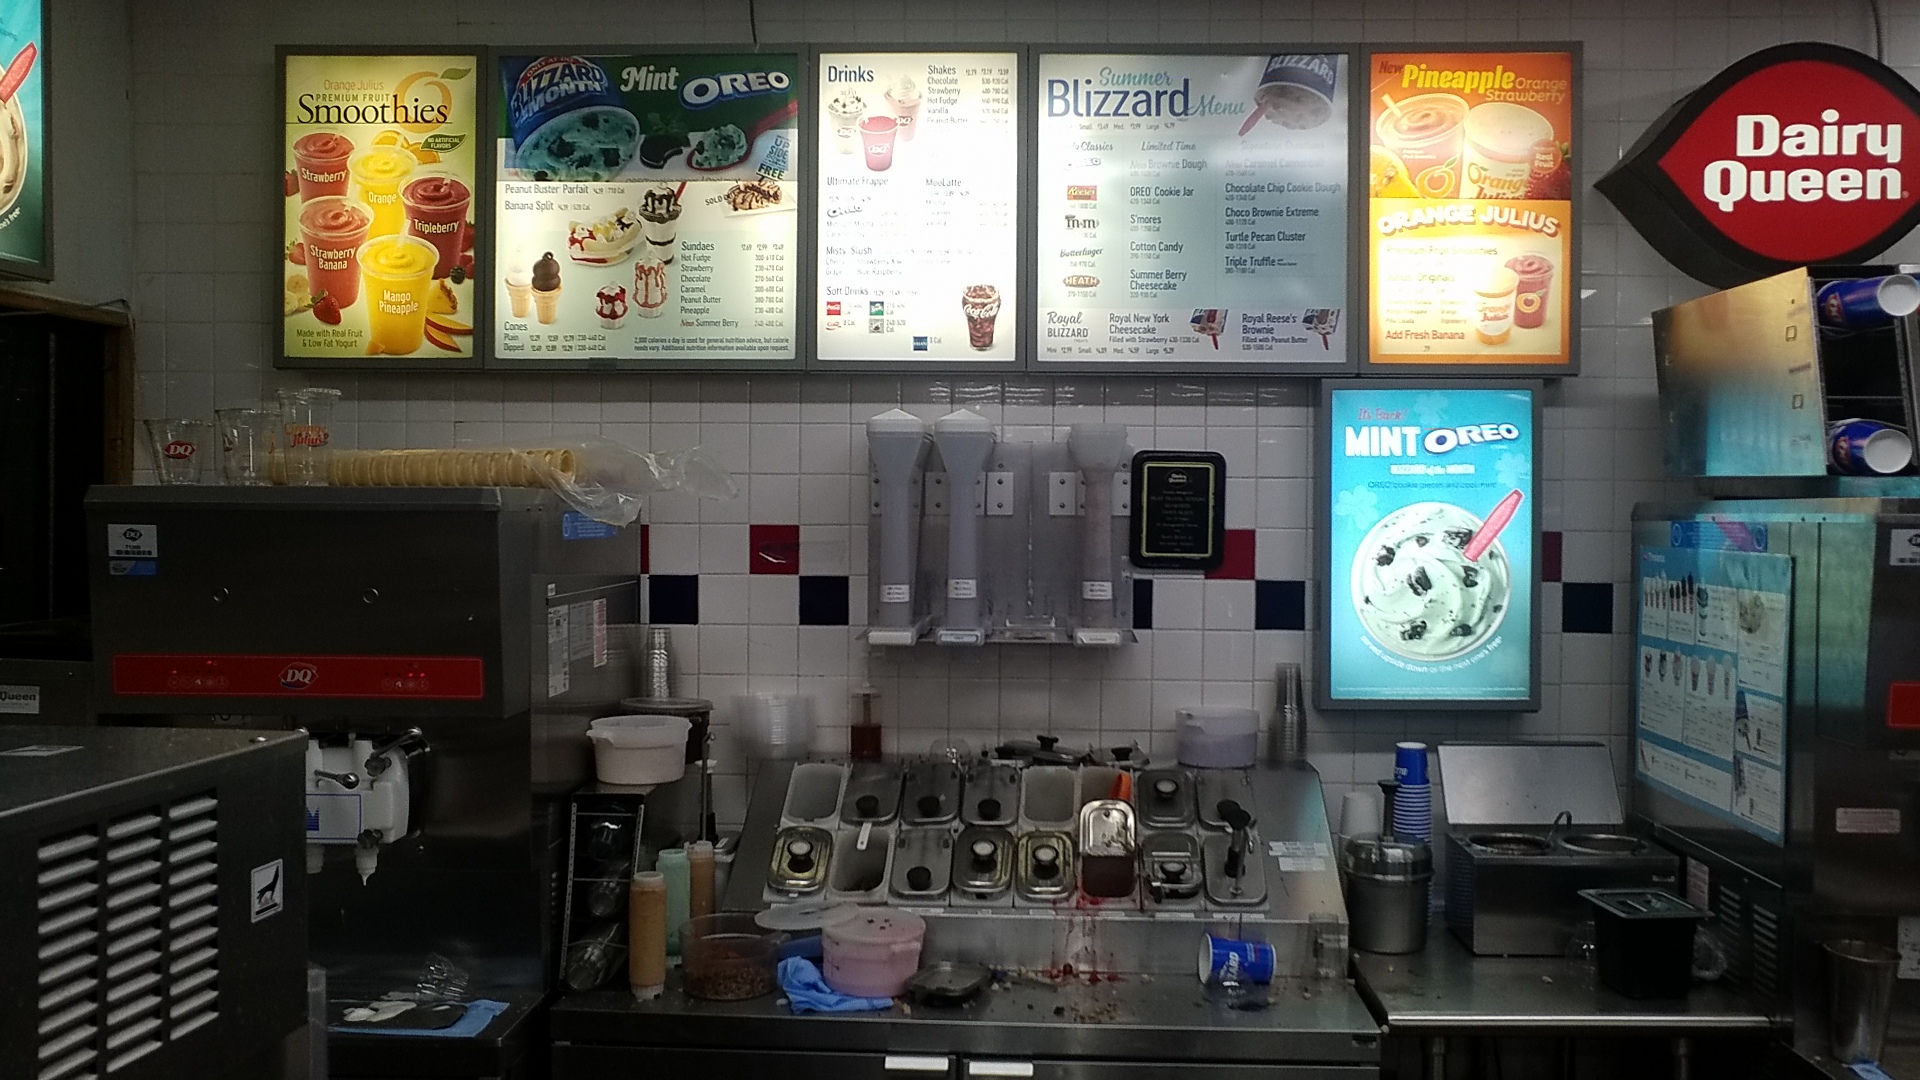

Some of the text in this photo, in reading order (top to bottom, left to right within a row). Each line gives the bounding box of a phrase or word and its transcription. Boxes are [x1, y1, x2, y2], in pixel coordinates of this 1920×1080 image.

[526, 61, 546, 76] ONLY
[828, 64, 874, 82] Drinks
[927, 64, 957, 75] Shakes
[1267, 54, 1335, 86] BLIZZARD
[927, 76, 958, 85] Chocolate
[1099, 66, 1173, 87] Summer
[1379, 61, 1567, 94] New Pineapple Orange
[324, 79, 384, 92] Orange Julius
[620, 65, 790, 105] Mint OREO
[927, 86, 961, 96] Strawberry
[1485, 88, 1566, 104] Strawberry
[315, 93, 391, 102] PREMIUM FRUIT
[939, 97, 958, 106] Fudge
[1047, 77, 1245, 118] Blizzard Menu
[297, 93, 449, 124] Smoothies
[1736, 109, 1903, 163] Dairy
[1080, 141, 1113, 151] Classics
[1141, 141, 1196, 151] Limited Time
[1148, 159, 1207, 171] Brownie Dough
[301, 167, 347, 183] Strawberry
[758, 163, 784, 180] FREE
[827, 176, 889, 187] Ultimate Frappe
[1703, 160, 1902, 212] Queen
[504, 183, 589, 194] Peanut Buster Parfait
[1130, 186, 1194, 197] OREO Cookie Jar
[1225, 182, 1341, 194] Chocolate Chip Cookie Dough
[368, 191, 397, 206] Orange
[705, 195, 722, 206] SOLD
[504, 200, 554, 212] Banana Split
[1225, 206, 1319, 217] Choco Brownie Extreme
[1130, 214, 1162, 224] S'mores
[1378, 203, 1560, 236] ORANGE JULIUS
[413, 219, 459, 235] Tripleberry
[1225, 231, 1306, 241] Turtle Pecan Cluster
[681, 240, 715, 251] Sundaes
[850, 245, 873, 255] Slush
[1130, 241, 1184, 254] Cotton Candy
[310, 244, 356, 260] Strawberry
[1059, 247, 1104, 258] Butterfinger
[680, 253, 711, 263] Hot Fudge
[1225, 256, 1248, 269] Triple
[1249, 256, 1275, 267] Truffle
[318, 259, 348, 270] Banana
[680, 263, 714, 273] Strawberry
[680, 274, 711, 283] Chocolate
[1065, 276, 1097, 285] HEATH
[1130, 269, 1187, 281] Summer Berry
[680, 285, 706, 293] Caramel
[1130, 280, 1177, 290] Cheesecake
[383, 289, 411, 303] Mango
[826, 286, 869, 296] Soft Drinks
[680, 296, 721, 304] Peanut Butter
[378, 300, 418, 315] Pineapple
[680, 306, 710, 315] Pineapple
[695, 318, 721, 327] Summer
[722, 319, 739, 328] Berry
[1046, 311, 1083, 327] Royal
[1109, 312, 1170, 325] Royal New York
[1241, 313, 1297, 324] Royal Reese's
[504, 321, 528, 331] Cones
[1109, 324, 1157, 335] Cheesecake
[1242, 325, 1275, 335] Brownie
[296, 328, 363, 338] Made with Real Fruit
[504, 333, 519, 341] Plain
[1047, 328, 1089, 338] BLIZZARD
[1385, 330, 1465, 340] Add Fresh Banana
[308, 339, 323, 348] Low
[324, 339, 335, 348] Fat
[335, 339, 357, 349] Yogurt
[1138, 336, 1168, 344] Strawberry
[1290, 336, 1308, 344] Butter
[504, 343, 525, 353] Dipped
[1357, 408, 1374, 420] It's
[285, 422, 327, 435] Orange
[291, 432, 325, 448] Julius
[1345, 422, 1520, 457] MINT OREO
[166, 443, 194, 457] DQ
[125, 531, 140, 539] DQ
[1405, 663, 1428, 673] down
[286, 668, 313, 684] DQ
[0, 691, 37, 702] Queen
